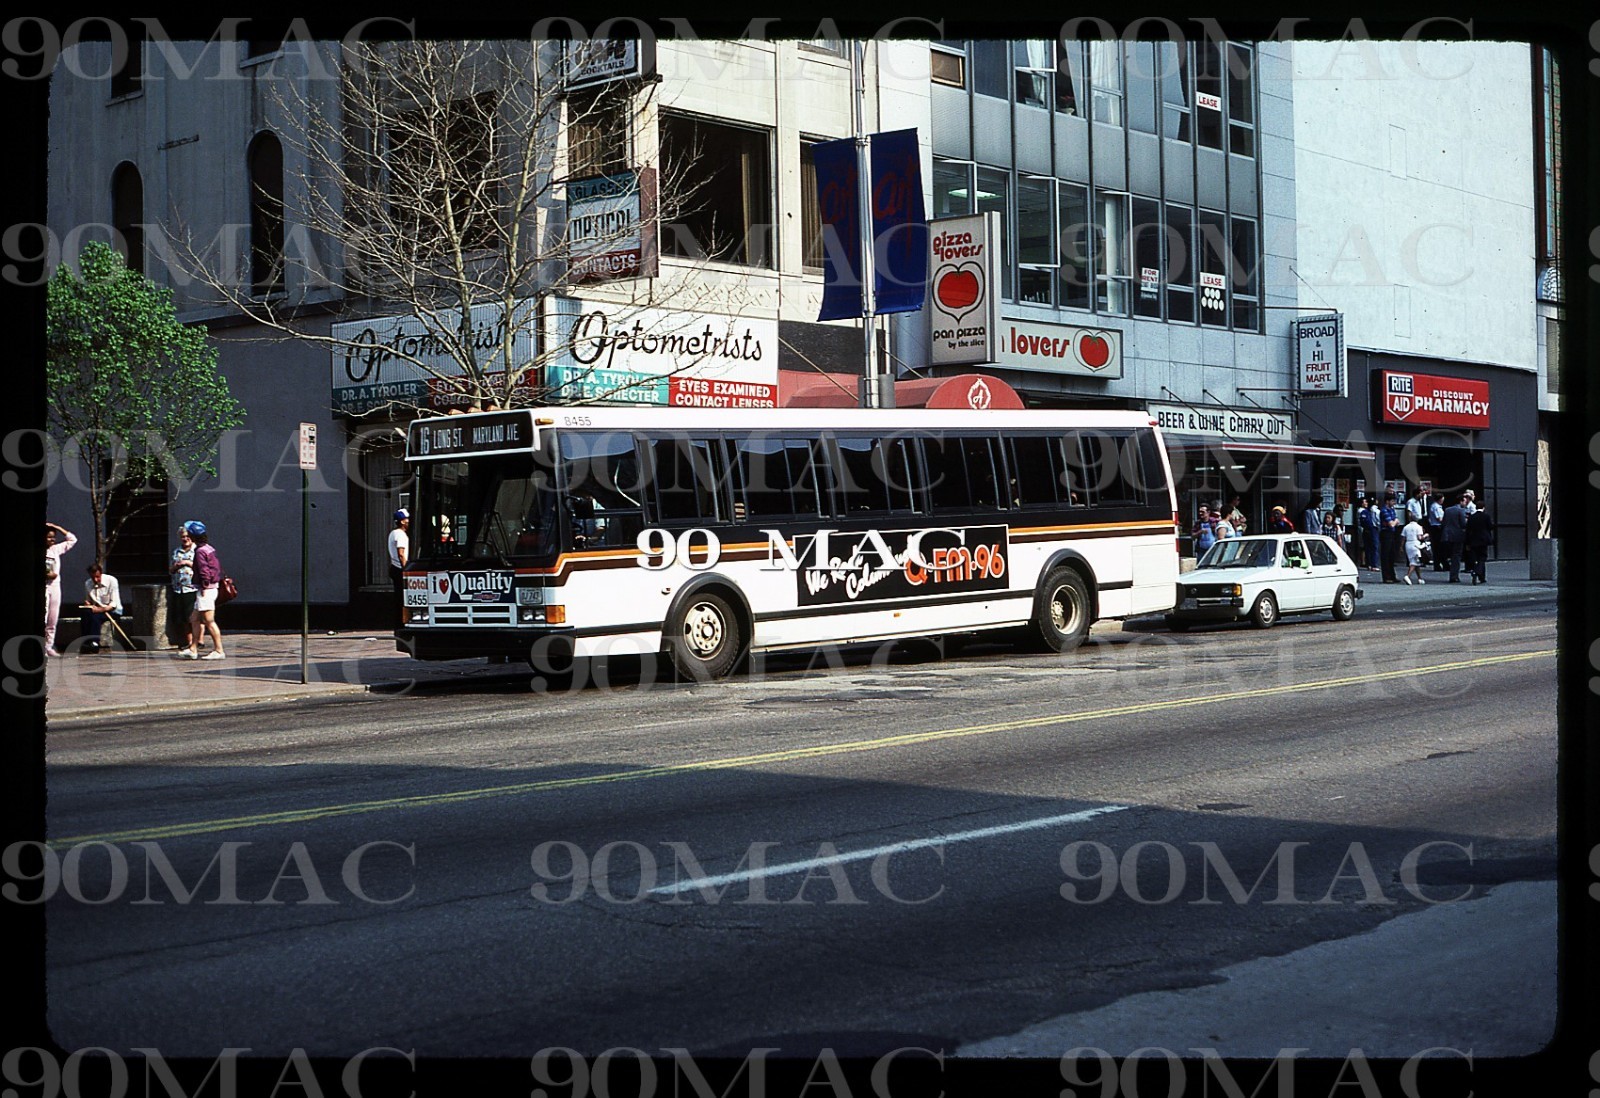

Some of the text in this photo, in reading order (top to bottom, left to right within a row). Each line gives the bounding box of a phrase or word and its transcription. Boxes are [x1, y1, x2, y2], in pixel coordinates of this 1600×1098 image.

[1198, 96, 1218, 108] LEASE
[933, 231, 972, 255] pizza
[940, 243, 984, 262] lovers
[1203, 275, 1222, 287] LEASE
[570, 311, 762, 368] Optometrists
[933, 326, 985, 341] pan pizza
[1300, 325, 1335, 339] BROAD
[948, 341, 956, 349] by
[958, 340, 969, 348] the
[1010, 326, 1070, 358] lovers
[1312, 350, 1324, 361] HI
[1306, 362, 1331, 372] FRUIT
[370, 383, 417, 398] TYROLER
[679, 380, 770, 398] EYES EXAMINED
[1391, 377, 1411, 392] RITE
[595, 386, 659, 402] SCHECTER
[675, 393, 774, 408] CONTACT LENSES
[1433, 389, 1474, 401] DISCOUNT
[1393, 397, 1410, 412] AID
[1414, 396, 1489, 416] PHARMACY
[564, 416, 592, 426] 8455
[1158, 411, 1286, 435] BEER & WINE CARRY OUT
[420, 427, 429, 455] 16
[433, 428, 451, 449] LONG
[453, 428, 464, 447] ST.
[472, 425, 503, 444] MARYLAND
[432, 575, 438, 594] i
[453, 573, 513, 600] Quality
[408, 594, 427, 605] 8455
